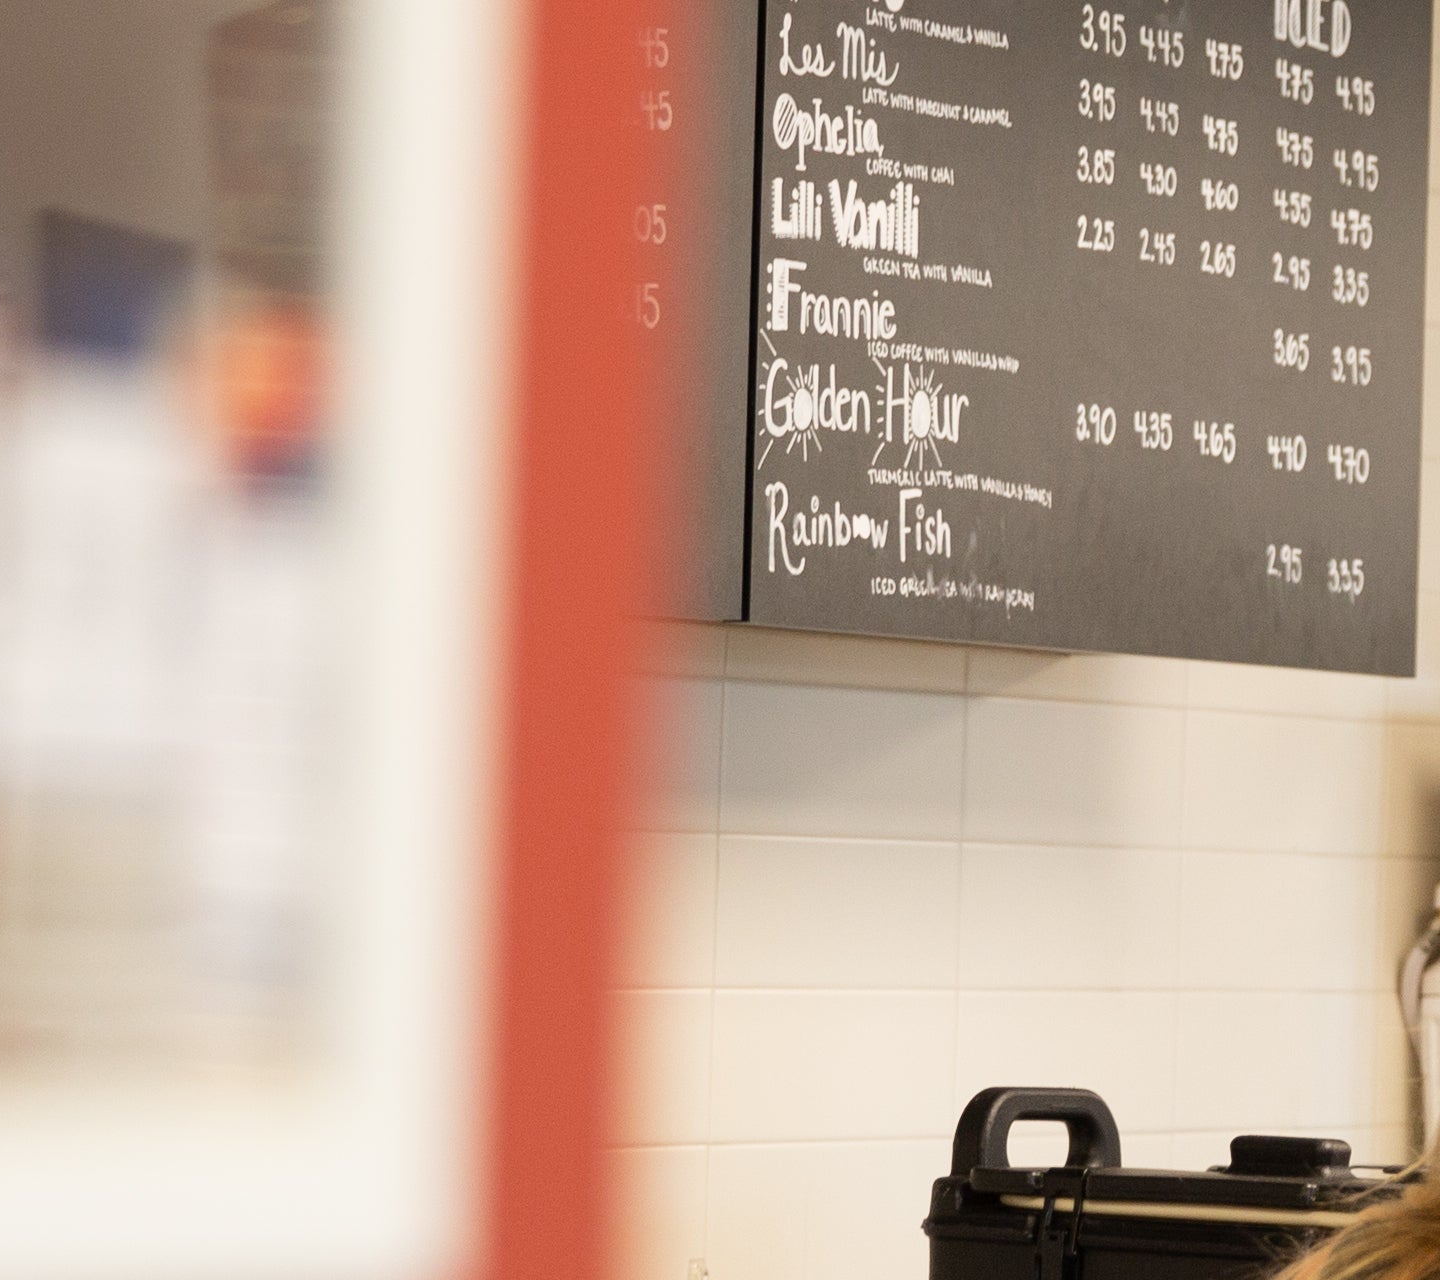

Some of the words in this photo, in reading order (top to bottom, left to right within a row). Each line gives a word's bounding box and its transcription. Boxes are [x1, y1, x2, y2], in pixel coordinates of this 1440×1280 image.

[779, 12, 835, 77] Les
[837, 22, 900, 86] Mis
[866, 8, 898, 33] LATTE
[900, 16, 924, 36] WITH
[1079, 3, 1127, 58] 3.95
[1139, 25, 1184, 68] 4.45
[1205, 38, 1244, 81] 4.75
[1275, 58, 1313, 105] 4.75
[1335, 75, 1375, 117] 4.95
[863, 87, 888, 105] LATTE
[890, 93, 914, 111] WITH
[1078, 78, 1116, 121] 3.95
[1140, 96, 1180, 137] 4.45
[1202, 114, 1239, 157] 4.75
[1276, 126, 1313, 170] 4.75
[1333, 148, 1379, 193] 4.95
[866, 158, 902, 177] COFFEE
[903, 165, 929, 182] WITH
[931, 166, 955, 186] CHAI
[1077, 145, 1115, 185] 3.85
[1140, 162, 1177, 197] 4.30
[1201, 178, 1239, 211] 4.60
[1273, 188, 1312, 229] 4.55
[1330, 208, 1373, 251] 4.75
[772, 176, 822, 241] Lilli
[828, 178, 920, 259] Vanilli
[863, 256, 900, 276] GREEN
[902, 262, 921, 280] TEA
[923, 263, 948, 283] WITH
[951, 264, 992, 288] VANILLA
[1077, 214, 1115, 252] 2.25
[1139, 227, 1176, 266] 2.45
[1200, 240, 1236, 278] 2.65
[1272, 251, 1310, 291] 2.95
[1332, 264, 1369, 306] 3.35
[768, 258, 897, 340] Frannie
[867, 341, 888, 358] ICED
[890, 343, 923, 362] COFFEE
[924, 345, 949, 364] WITH
[1273, 328, 1310, 372] 3.65
[1331, 345, 1372, 387] 3.95
[765, 358, 871, 438] Golden
[886, 362, 969, 445] Hour
[868, 468, 921, 488] TURMERIC
[924, 470, 953, 489] LATTE
[955, 473, 978, 491] WITH
[1076, 403, 1117, 446] 3.90
[1133, 410, 1173, 451] 4.35
[1193, 420, 1237, 464] 4.65
[1266, 434, 1307, 473] 4.40
[1327, 444, 1370, 484] 4.70
[765, 480, 889, 576] Rainbow
[899, 488, 951, 563] Fish
[871, 578, 896, 595] ICED
[1266, 544, 1302, 585] 2.95
[1327, 558, 1364, 596] 3.35
